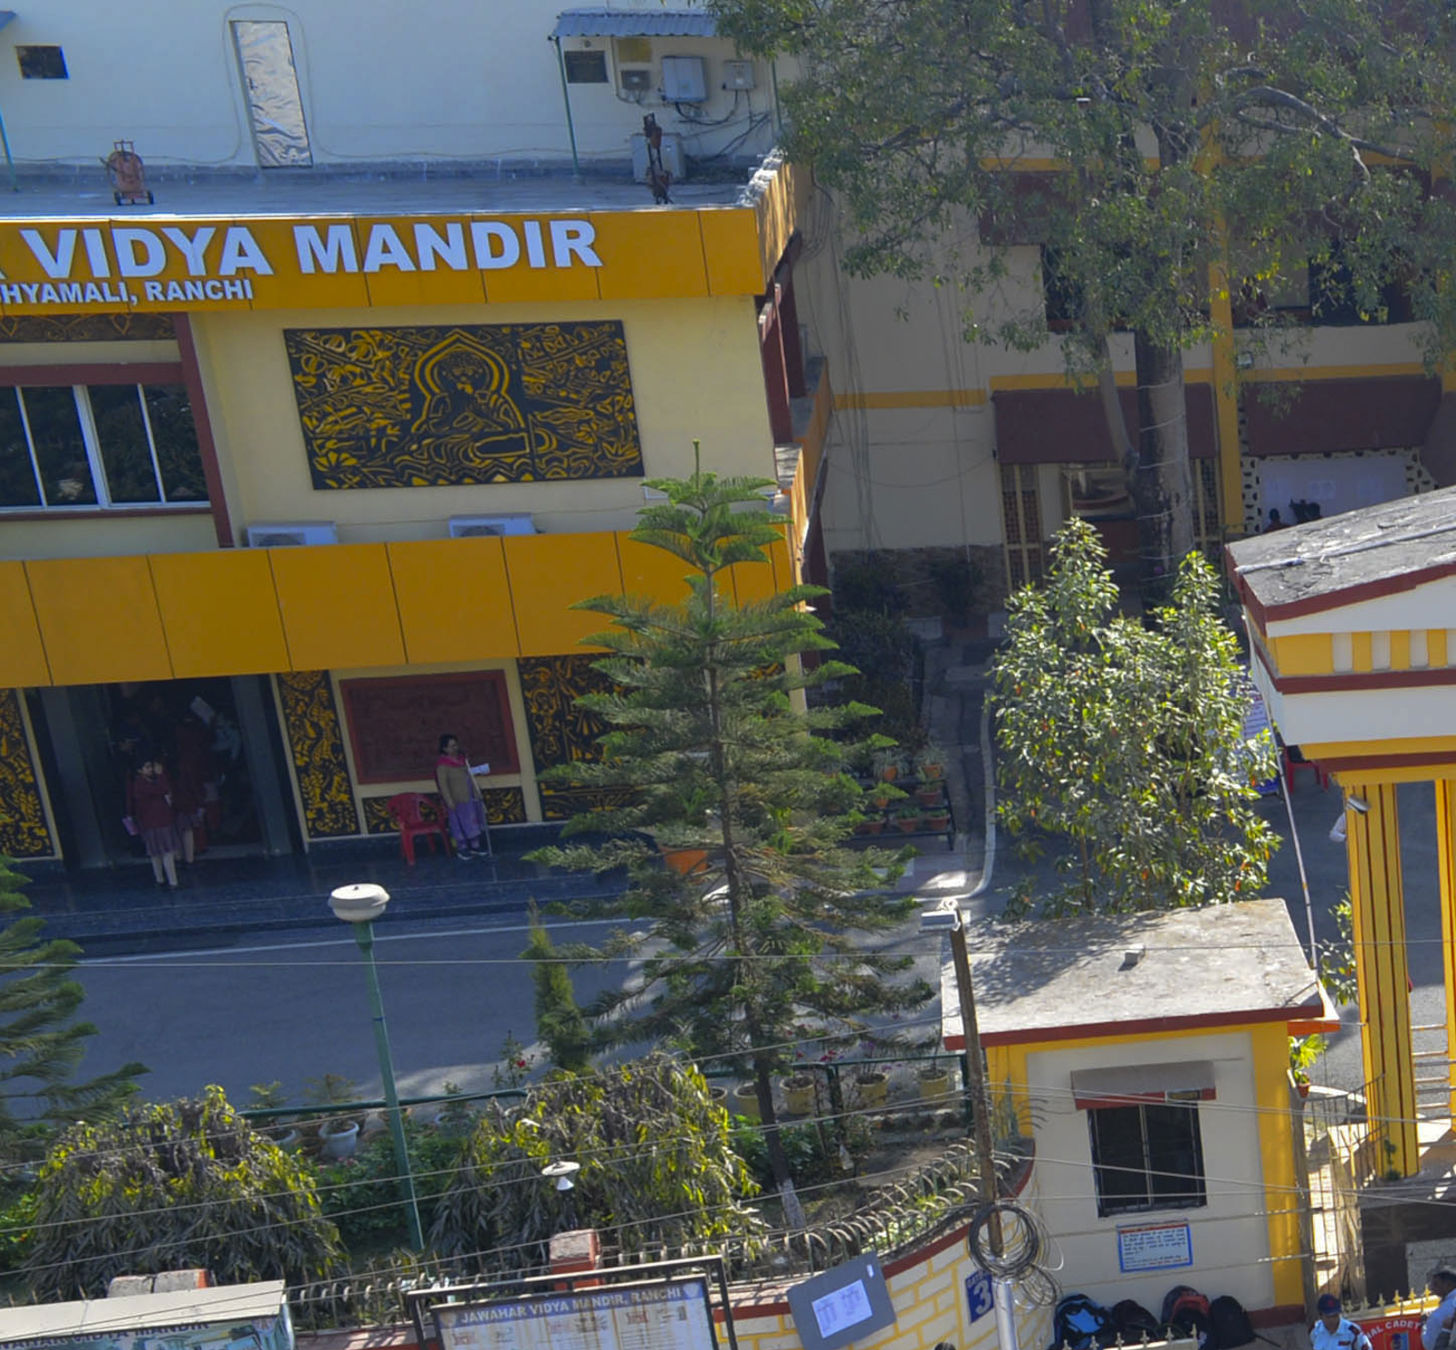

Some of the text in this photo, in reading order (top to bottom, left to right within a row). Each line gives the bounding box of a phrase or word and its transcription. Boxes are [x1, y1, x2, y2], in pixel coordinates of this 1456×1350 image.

[19, 219, 603, 279] VIDYA MANDIR
[0, 279, 253, 305] HYAMALI, RANCHI
[460, 1306, 527, 1323] JAWAHAR
[530, 1301, 569, 1316] VIDYA
[631, 1288, 682, 1303] RANCHI
[973, 1279, 992, 1315] 3
